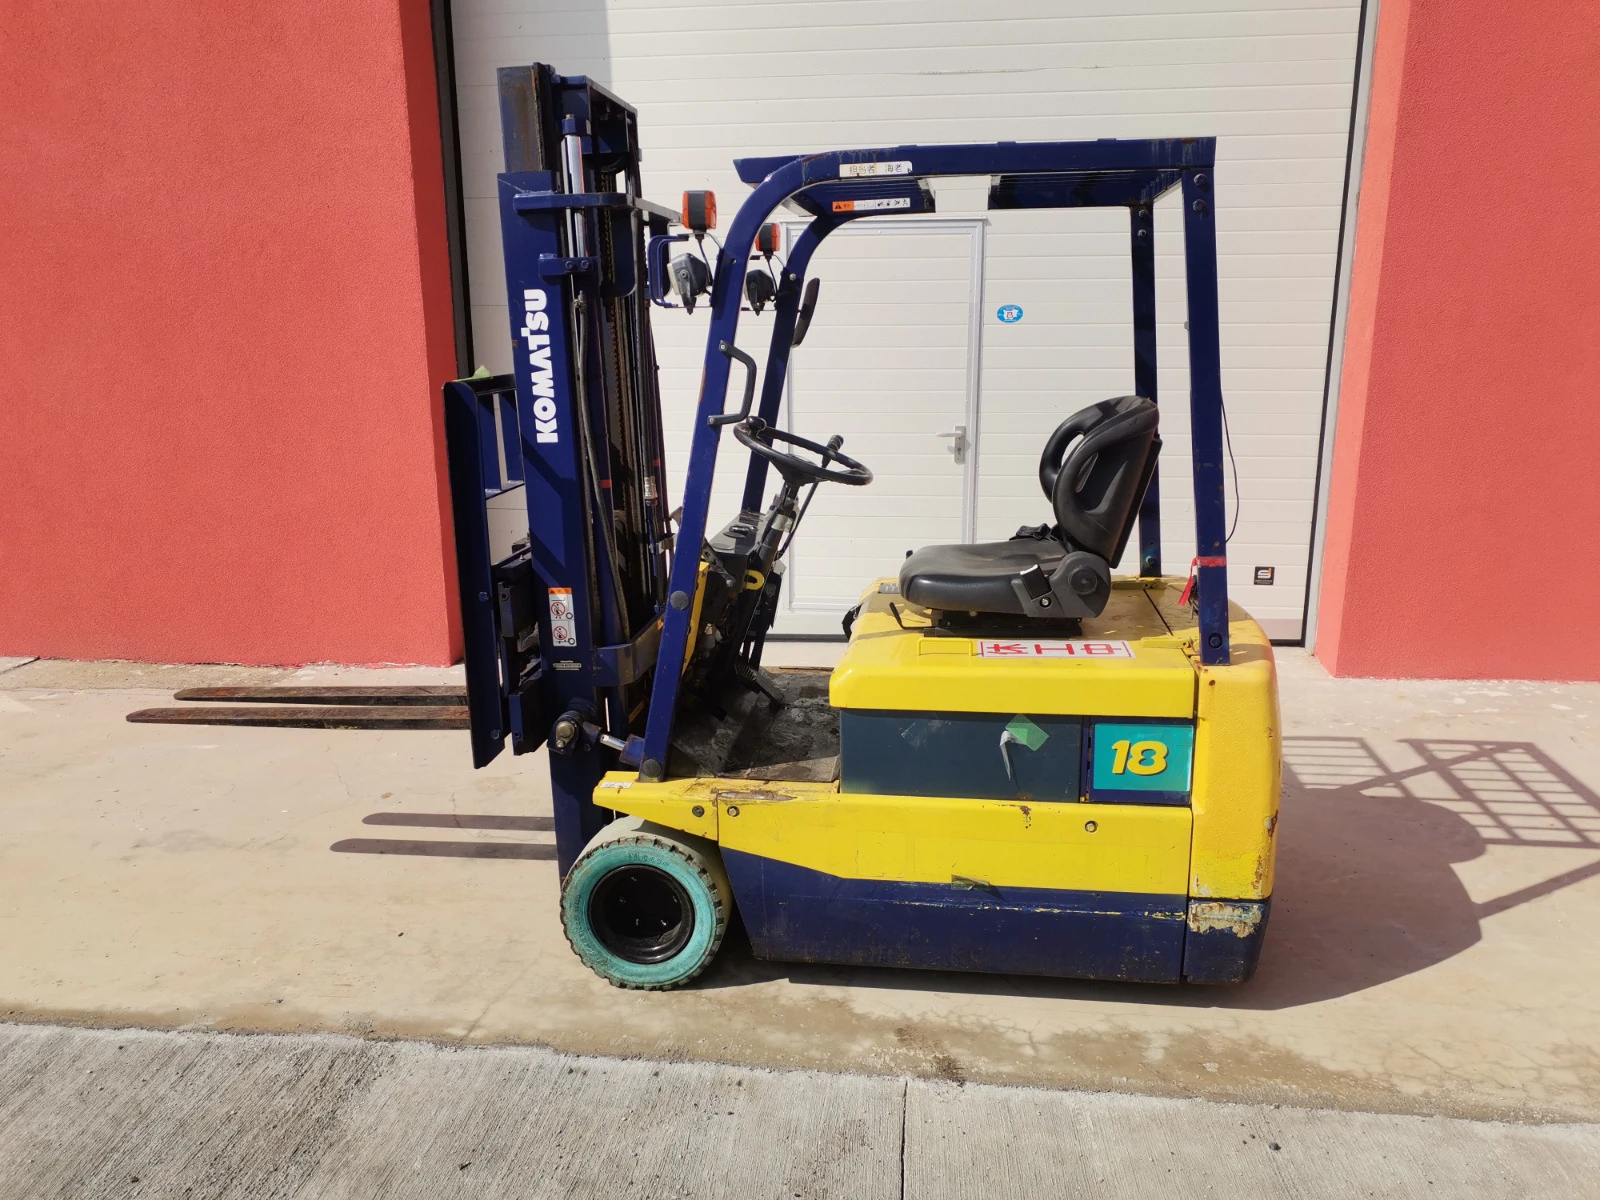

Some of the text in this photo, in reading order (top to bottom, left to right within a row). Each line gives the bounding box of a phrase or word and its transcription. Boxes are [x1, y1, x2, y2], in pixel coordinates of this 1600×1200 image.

[521, 288, 559, 444] KOMATSU
[986, 643, 1122, 655] 休工中
[1111, 740, 1169, 776] 18
